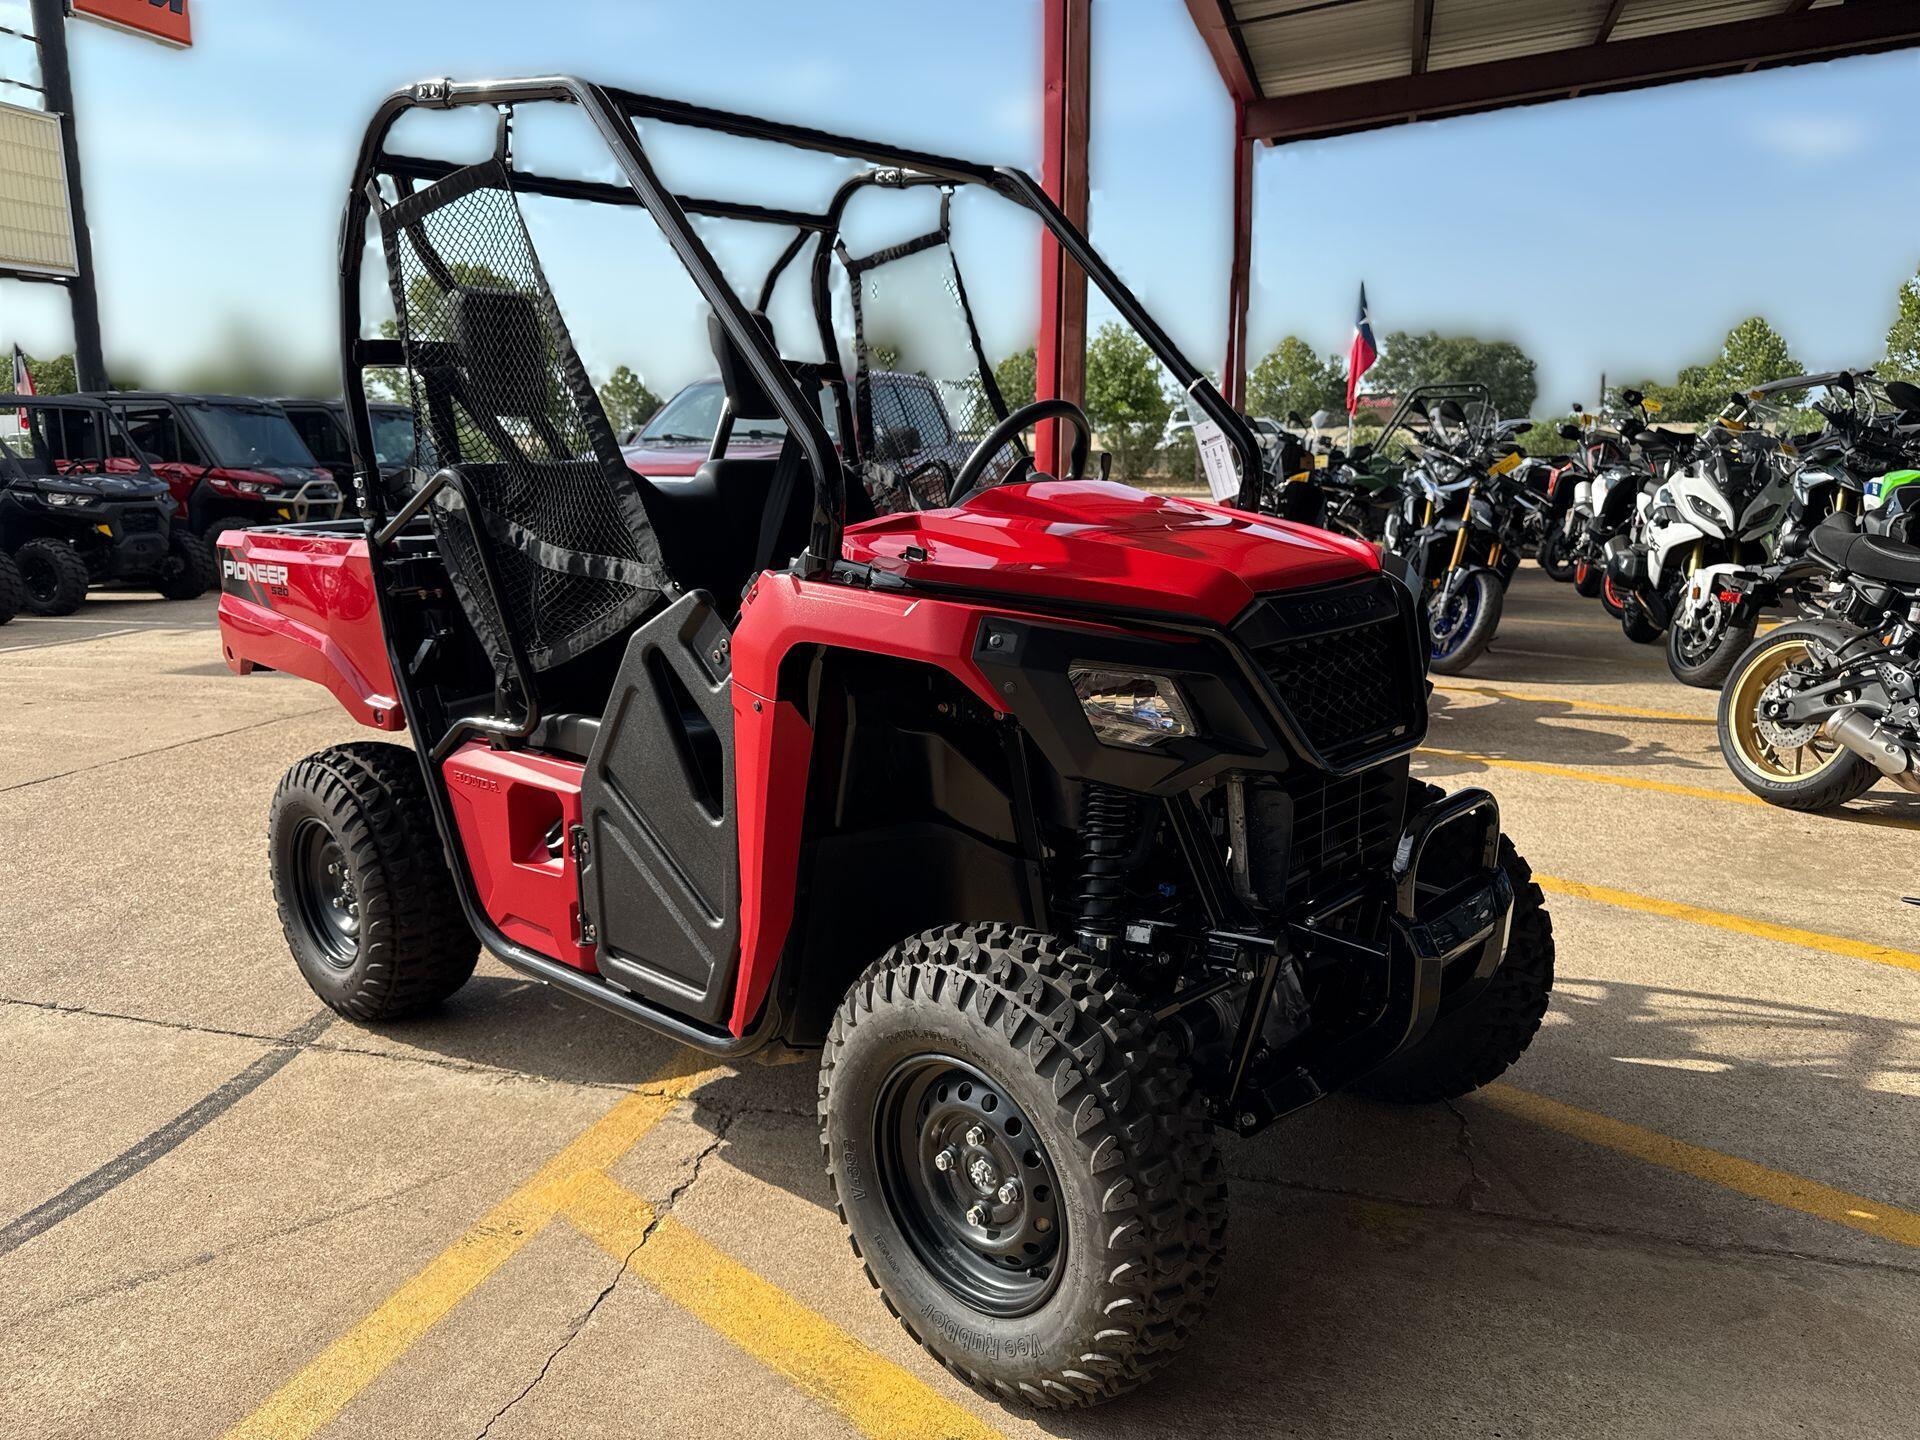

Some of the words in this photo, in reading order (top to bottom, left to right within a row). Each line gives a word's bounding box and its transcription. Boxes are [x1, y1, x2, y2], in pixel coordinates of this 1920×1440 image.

[223, 560, 289, 585] PIONEER
[271, 587, 289, 597] 520
[1298, 594, 1386, 623] HONDA
[453, 770, 501, 793] HONDA
[919, 1303, 1000, 1361] Rubber
[1004, 1333, 1045, 1360] Vee
